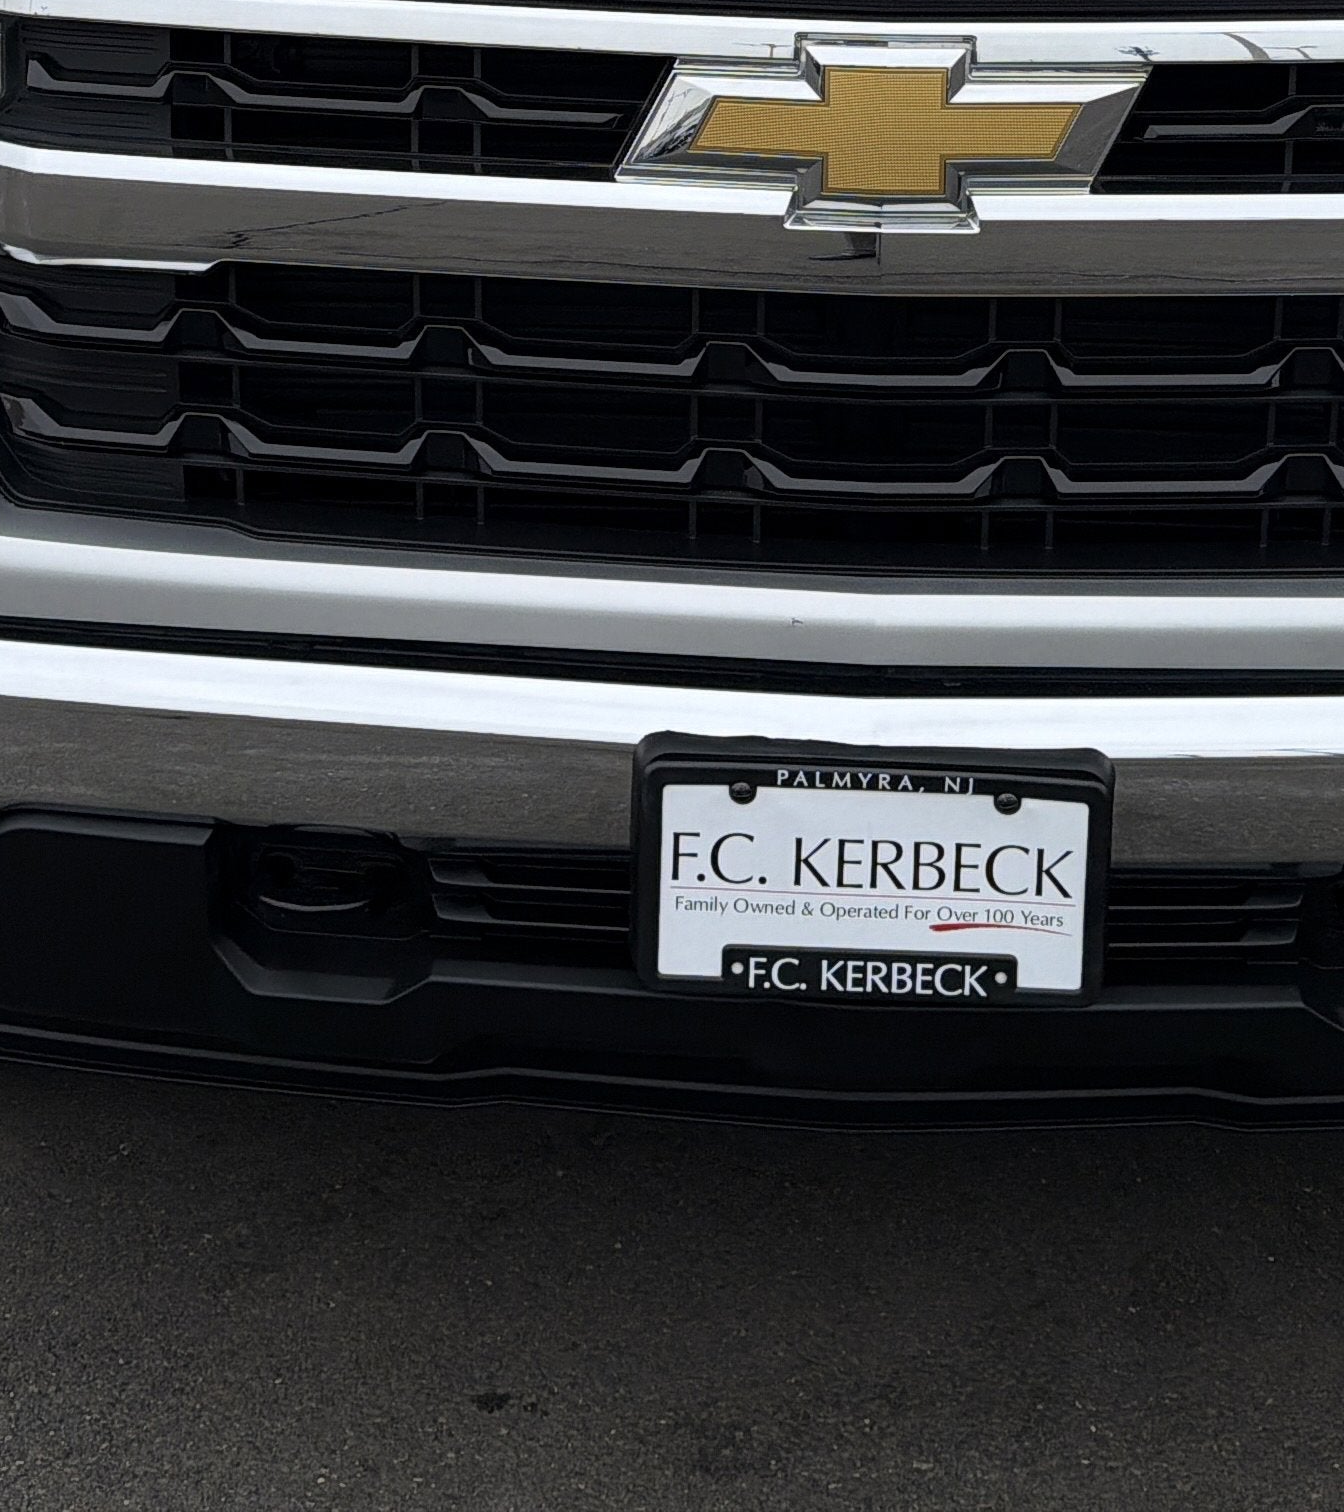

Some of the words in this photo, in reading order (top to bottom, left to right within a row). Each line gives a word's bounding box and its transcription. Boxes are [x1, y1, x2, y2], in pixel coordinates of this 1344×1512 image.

[776, 769, 925, 793] PALMYRA,
[944, 775, 974, 795] NJ
[671, 832, 767, 885] F.C.
[793, 837, 1074, 899] KERBECK
[675, 896, 729, 915] Family
[733, 898, 795, 915] Owned
[801, 902, 814, 916] &
[820, 902, 899, 921] Operated
[905, 905, 931, 921] For
[937, 906, 978, 922] Over
[984, 908, 1014, 923] 100
[1021, 910, 1064, 927] Years
[748, 957, 807, 991] F.C.
[820, 959, 988, 997] KERBECK
